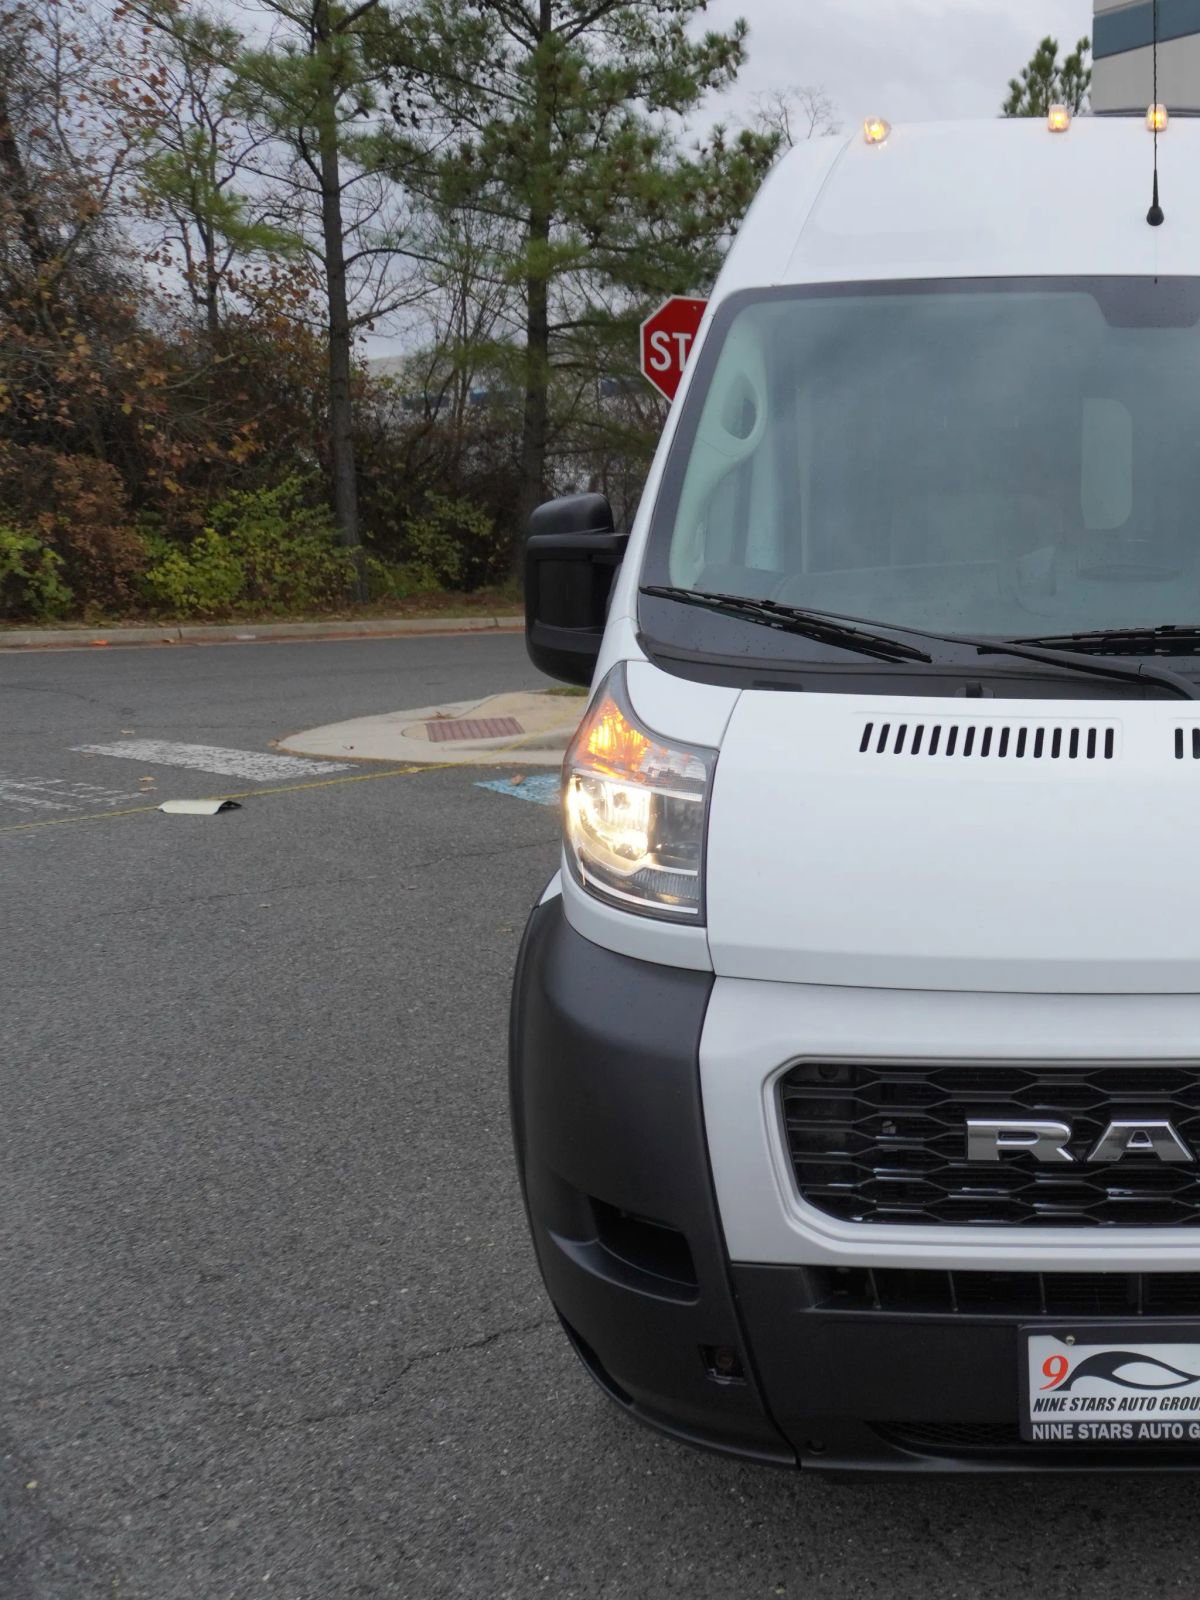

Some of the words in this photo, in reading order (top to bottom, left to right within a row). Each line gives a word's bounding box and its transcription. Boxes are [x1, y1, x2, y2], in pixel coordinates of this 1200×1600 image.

[650, 330, 692, 372] ST
[1039, 1355, 1069, 1391] 9
[1033, 1397, 1067, 1412] NINE
[1069, 1397, 1118, 1412] STARS
[1117, 1397, 1158, 1411] AUTO
[1032, 1424, 1074, 1440] NINE
[1078, 1423, 1133, 1439] STARS
[1138, 1423, 1184, 1439] AUTO
